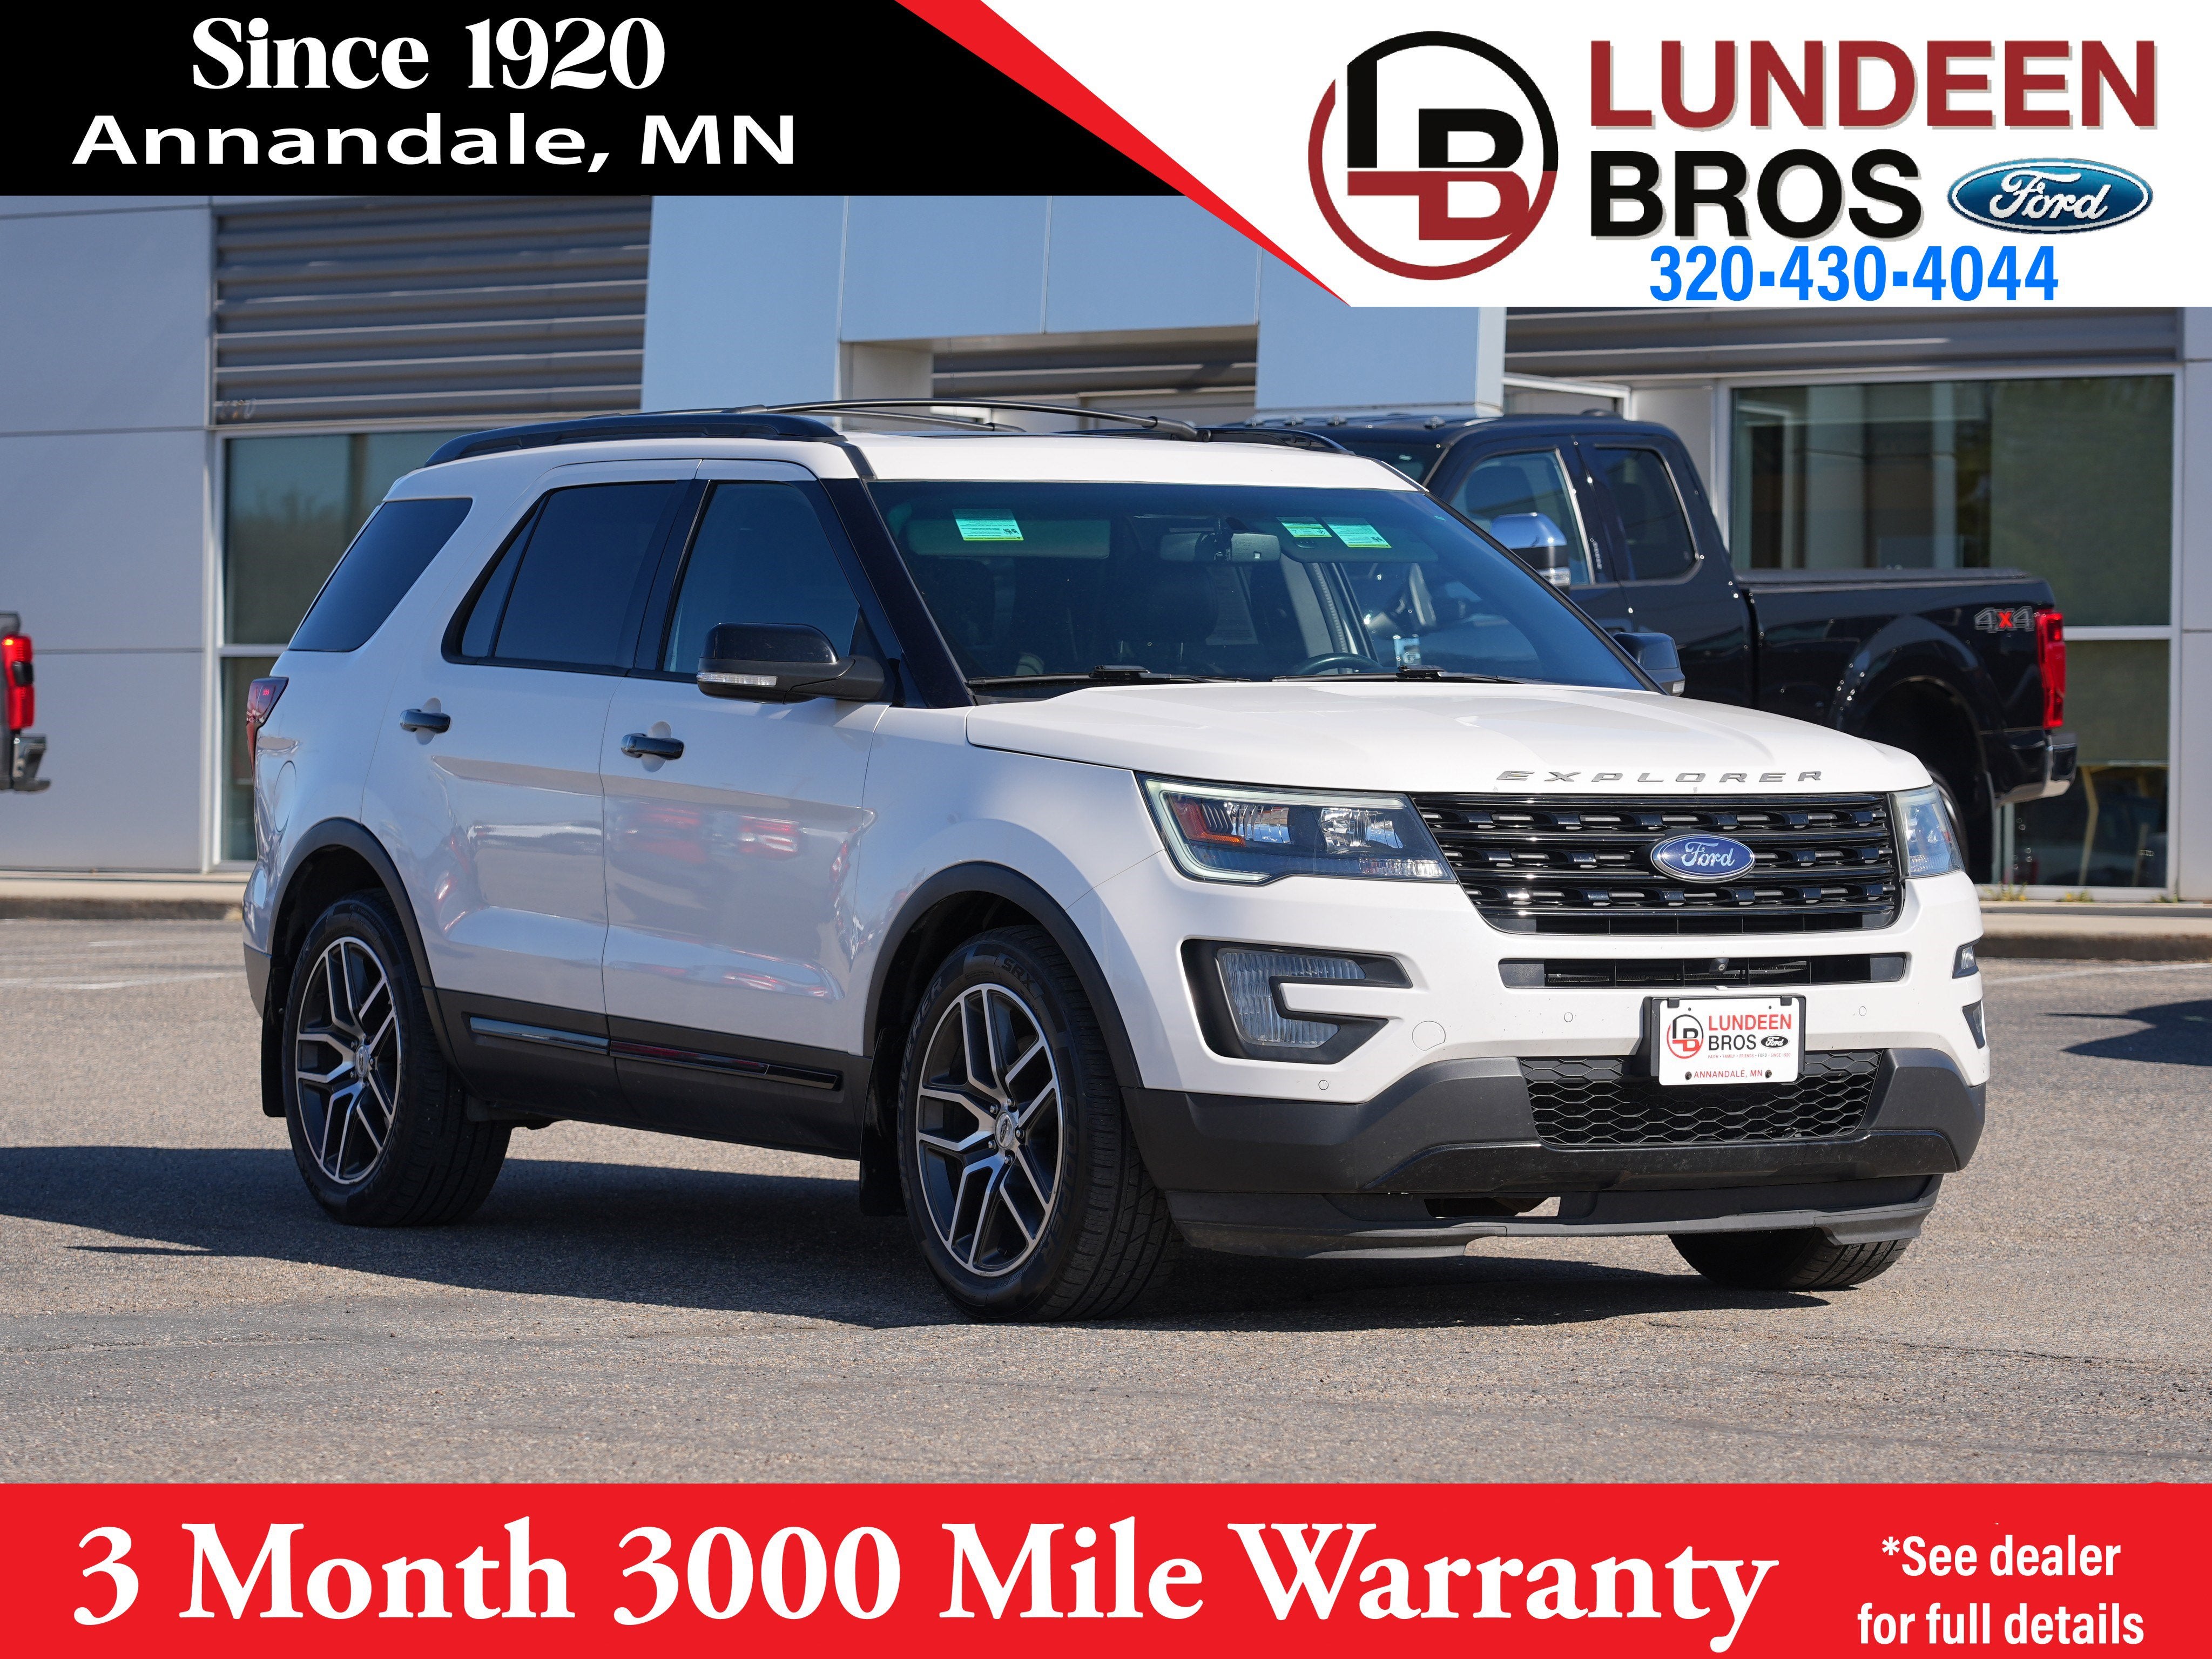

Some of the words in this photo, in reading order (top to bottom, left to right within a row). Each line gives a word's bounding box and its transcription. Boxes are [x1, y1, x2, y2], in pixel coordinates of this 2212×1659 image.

[1496, 770, 1822, 783] EXPLORER
[1681, 841, 1735, 868] Ford
[1002, 957, 1035, 990] SRX
[1709, 1014, 1791, 1031] LUNDEEN
[1709, 1034, 1756, 1050] BROS
[1765, 1036, 1784, 1047] Ford
[1694, 1070, 1747, 1078] ANNANDALE,
